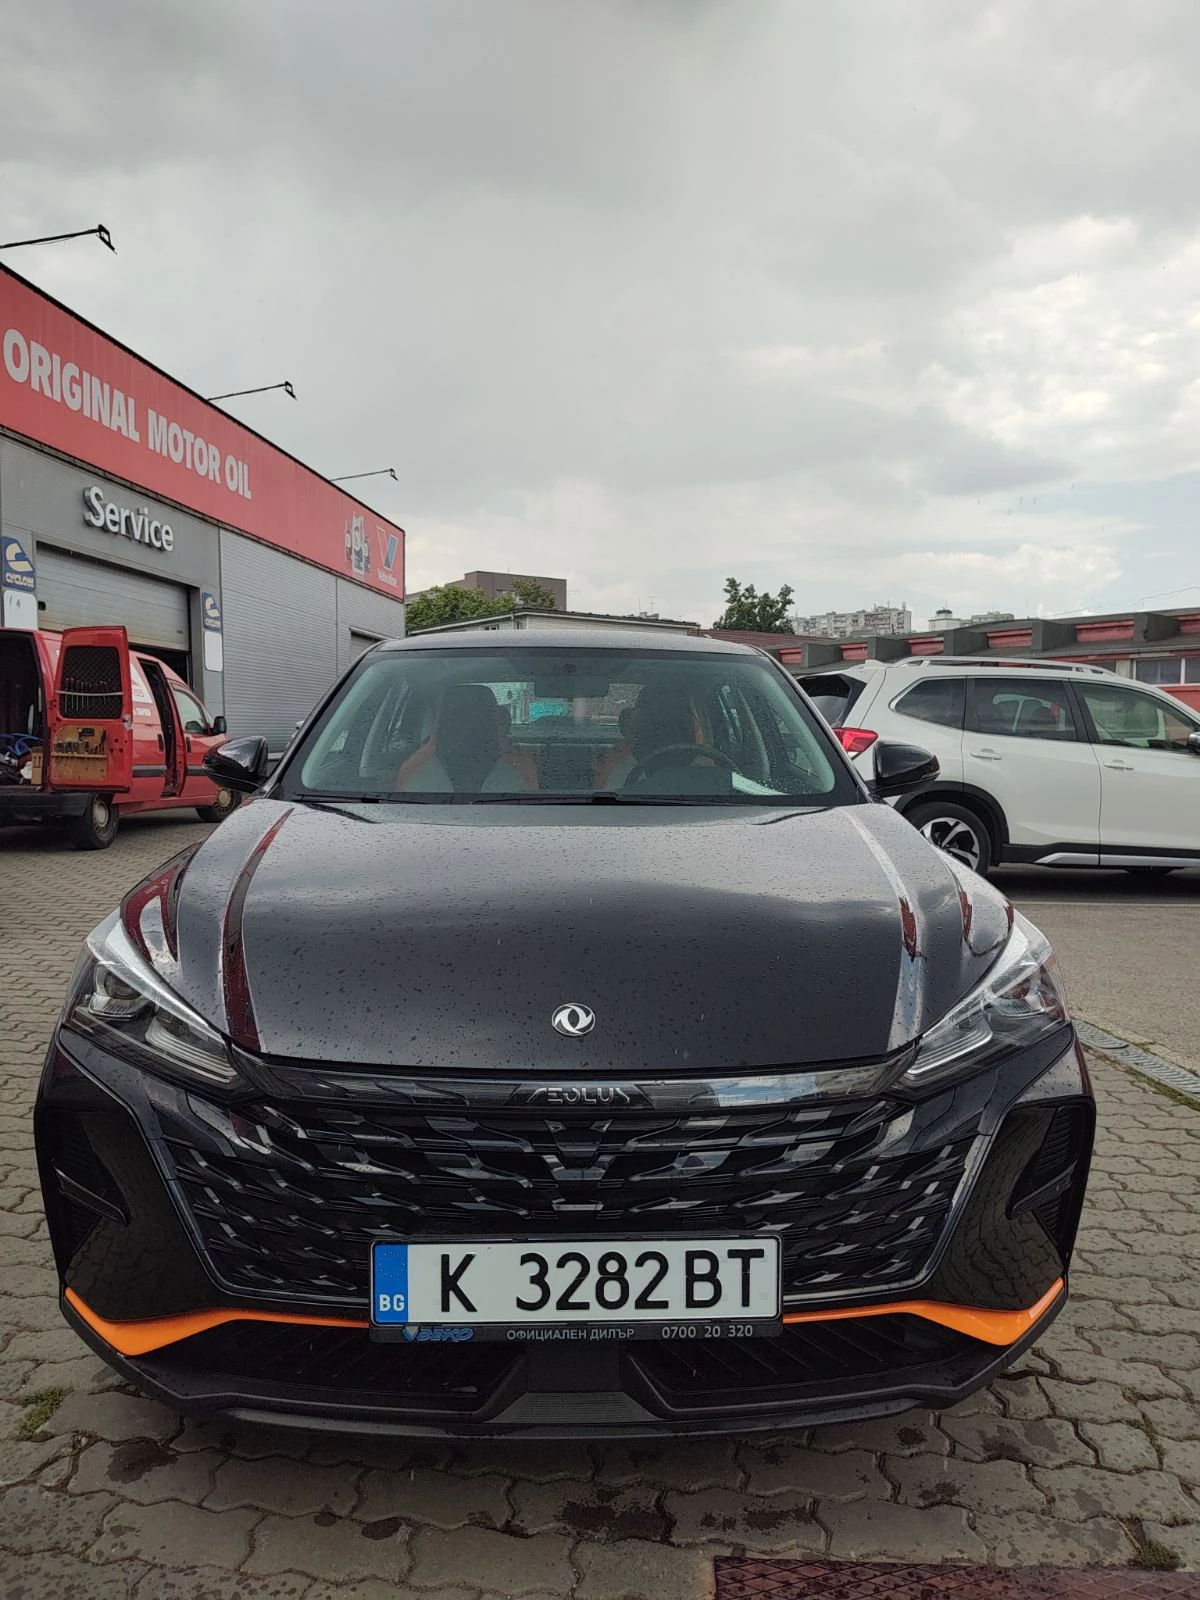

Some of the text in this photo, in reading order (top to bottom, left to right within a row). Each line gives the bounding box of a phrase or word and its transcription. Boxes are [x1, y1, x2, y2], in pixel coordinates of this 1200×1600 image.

[3, 328, 252, 500] ORIGINAL MOTOR OIL
[84, 485, 174, 552] Service
[515, 1250, 669, 1311] 3282
[379, 1294, 405, 1312] BG
[506, 1328, 635, 1341] ОФИЦИАЛЕН ДИЛЪР
[661, 1324, 753, 1339] 0700 20 320
